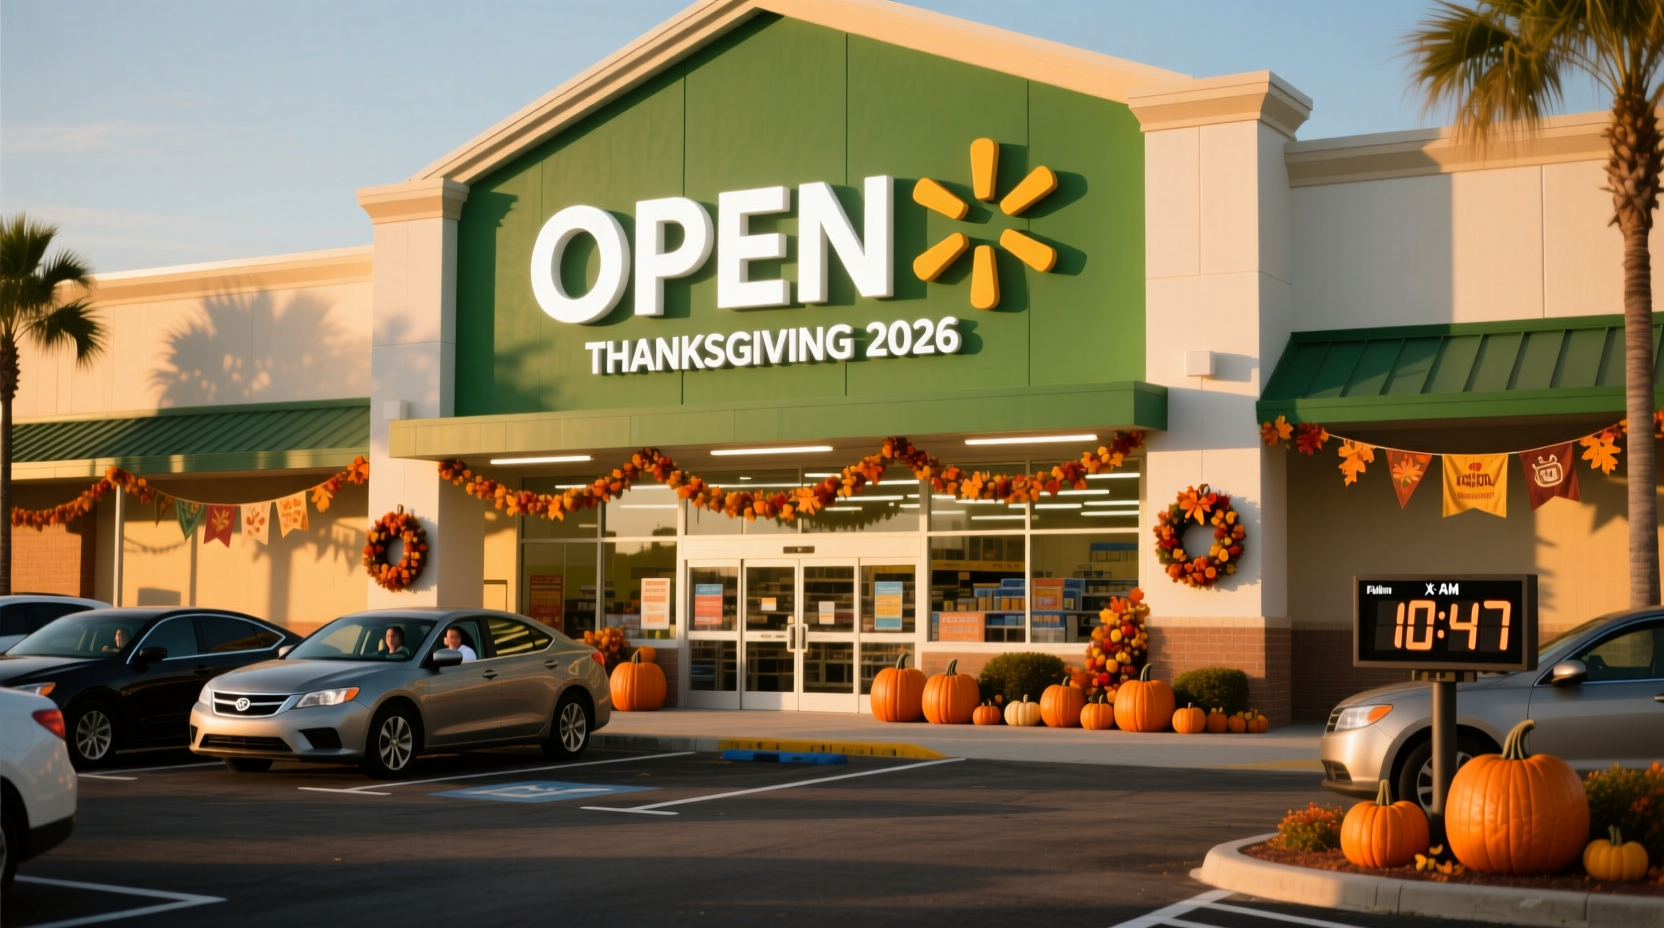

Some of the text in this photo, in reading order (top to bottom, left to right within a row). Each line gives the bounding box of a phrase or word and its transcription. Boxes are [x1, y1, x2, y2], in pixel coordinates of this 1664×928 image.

[530, 174, 894, 324] OPEN
[585, 316, 962, 375] THANKSGIVING 2026
[1394, 600, 1511, 650] 10:47
